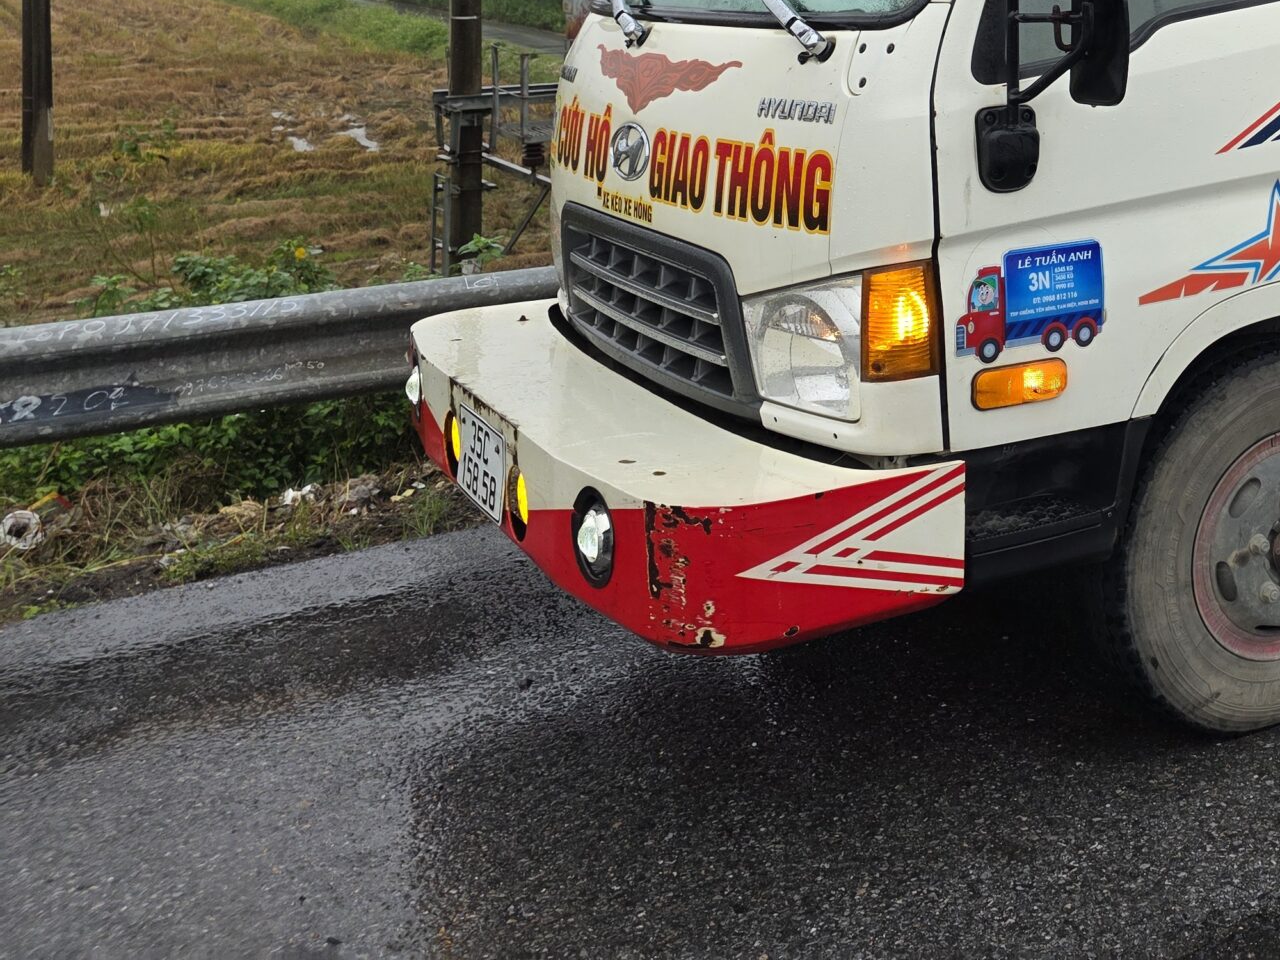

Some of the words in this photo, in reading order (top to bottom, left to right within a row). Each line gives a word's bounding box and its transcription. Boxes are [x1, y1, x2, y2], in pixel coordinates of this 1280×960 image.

[757, 97, 838, 124] HYUNDAI
[584, 103, 613, 199] HỘ
[649, 127, 709, 213] GIAO
[713, 128, 833, 234] THÔNG
[602, 192, 610, 209] XE
[611, 191, 622, 214] KÉO
[624, 197, 632, 217] XE
[1018, 256, 1031, 269] LÊ
[1035, 250, 1066, 267] TUẤN
[1068, 250, 1092, 262] ANH
[1028, 271, 1050, 291] 3N
[470, 420, 490, 465] 35C
[462, 452, 497, 511] 158.58
